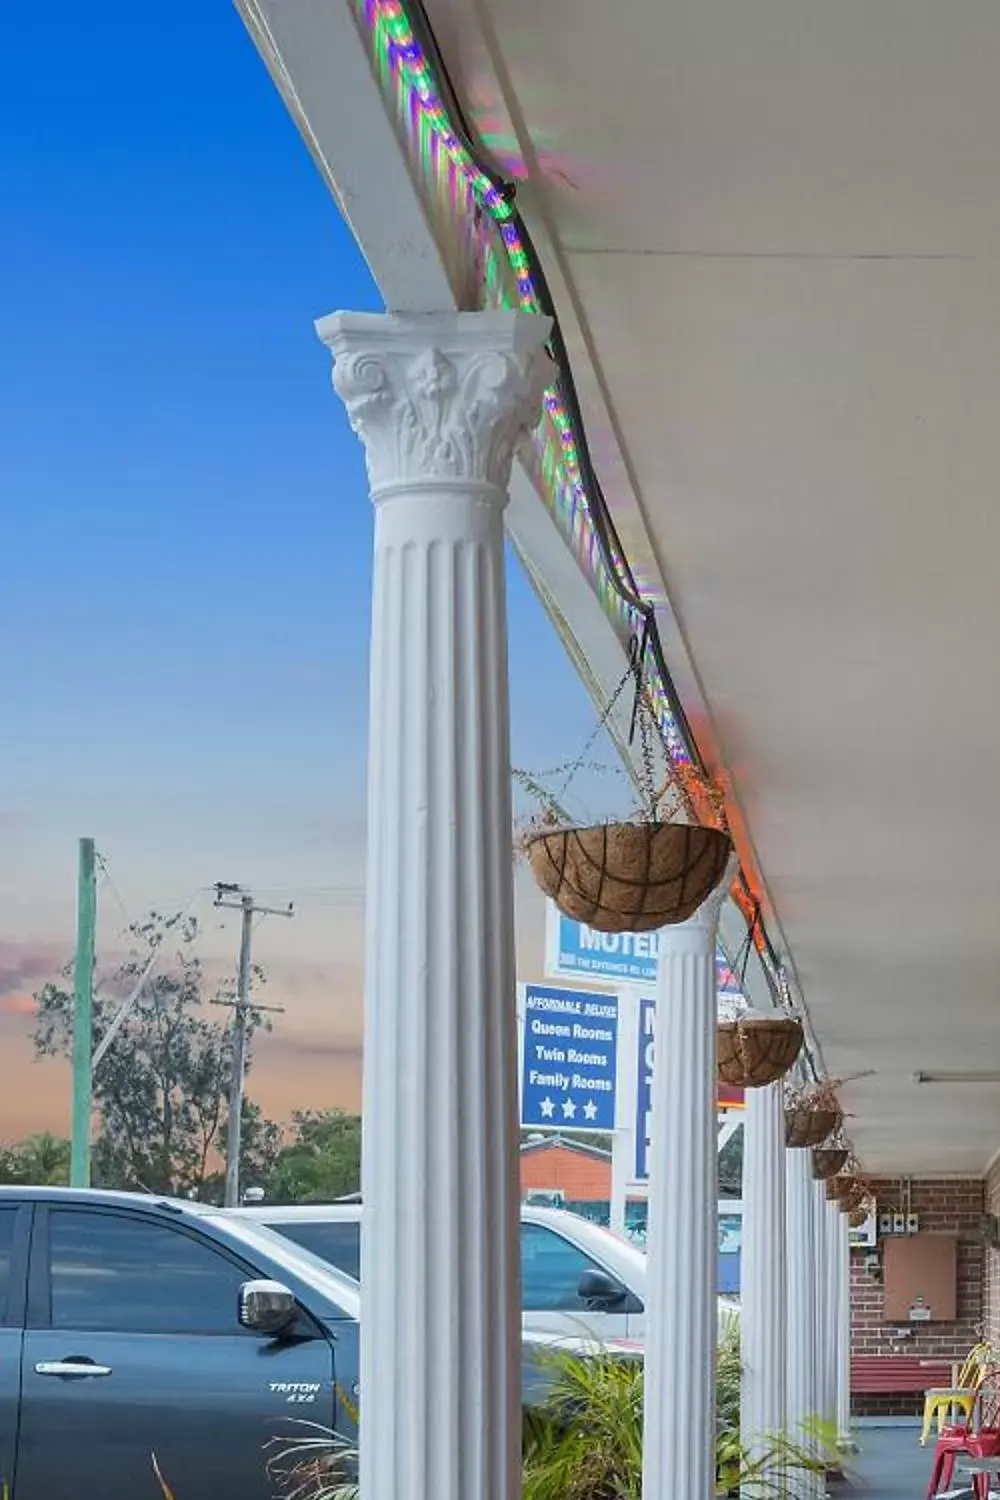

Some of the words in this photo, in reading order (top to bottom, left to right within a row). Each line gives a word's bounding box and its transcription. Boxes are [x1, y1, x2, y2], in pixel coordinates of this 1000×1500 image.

[579, 922, 659, 958] MOTEL
[527, 996, 581, 1014] AFFORDABLE
[531, 1019, 570, 1037] Queen
[573, 1024, 613, 1041] Rooms
[535, 1045, 565, 1062] Twin
[567, 1049, 607, 1066] Rooms
[529, 1070, 570, 1091] Family
[572, 1074, 612, 1091] Rooms
[268, 1382, 321, 1393] TRITON
